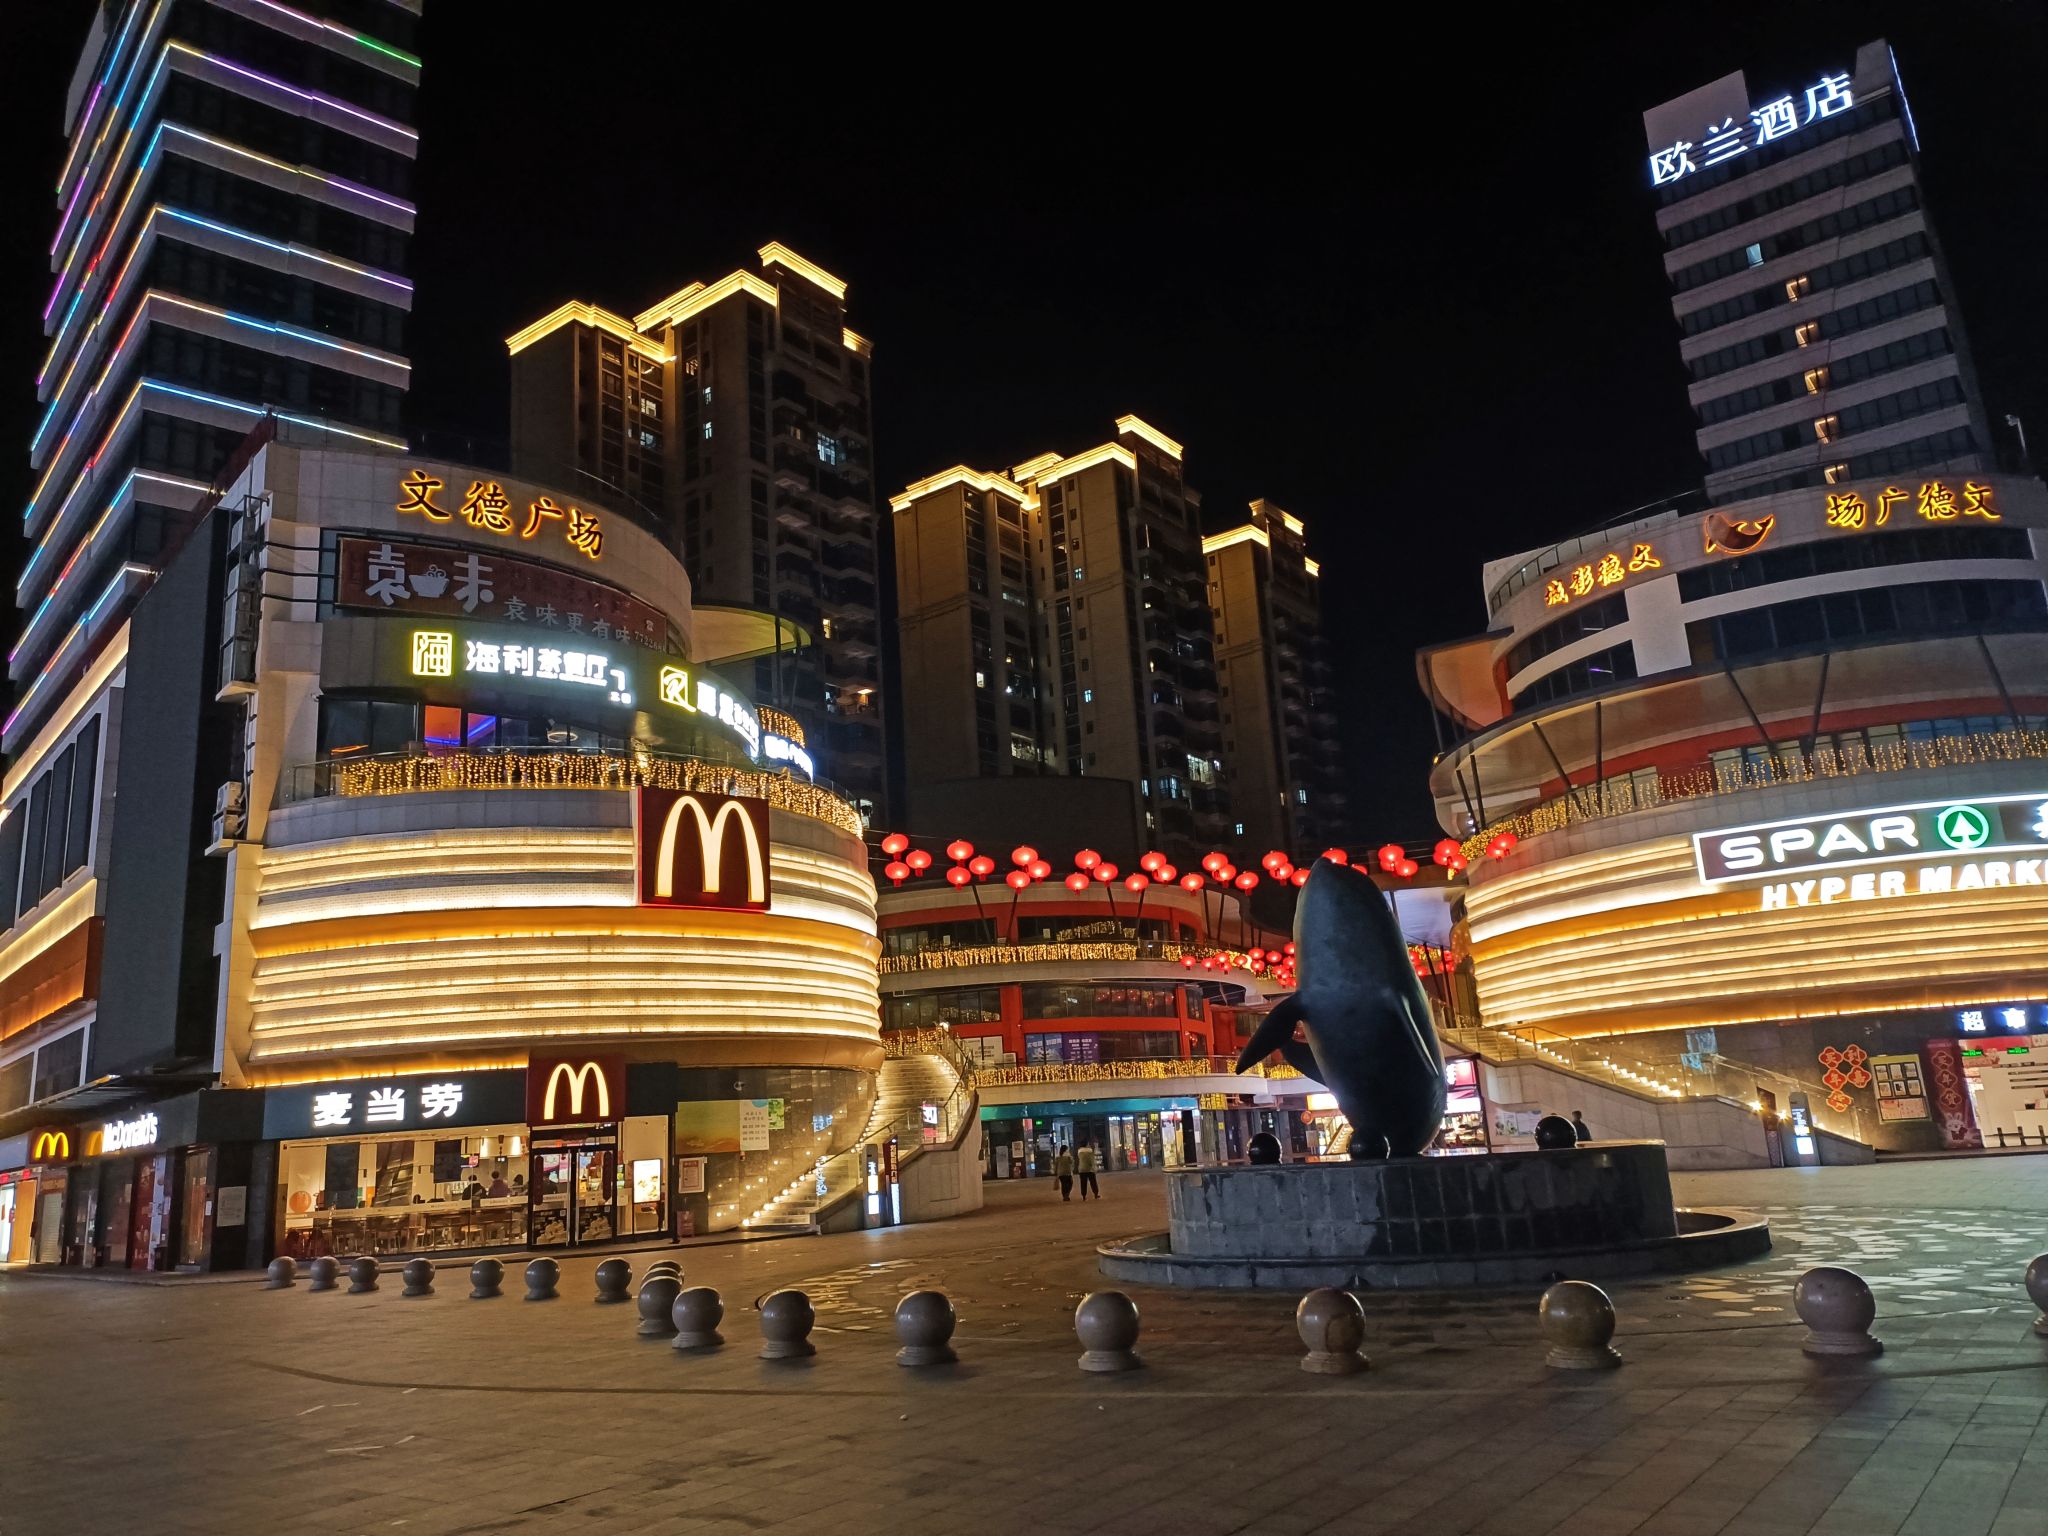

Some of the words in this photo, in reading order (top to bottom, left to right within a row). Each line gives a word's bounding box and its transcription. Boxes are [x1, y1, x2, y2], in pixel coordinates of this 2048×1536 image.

[1649, 72, 1854, 186] 欧兰酒店
[397, 469, 605, 560] 文德广场
[503, 595, 632, 645] 袁味更有味
[1720, 816, 1919, 869] SPAR
[1761, 871, 1906, 911] HYPER
[1919, 859, 2048, 894] MARK
[314, 1084, 464, 1127] 麦当劳
